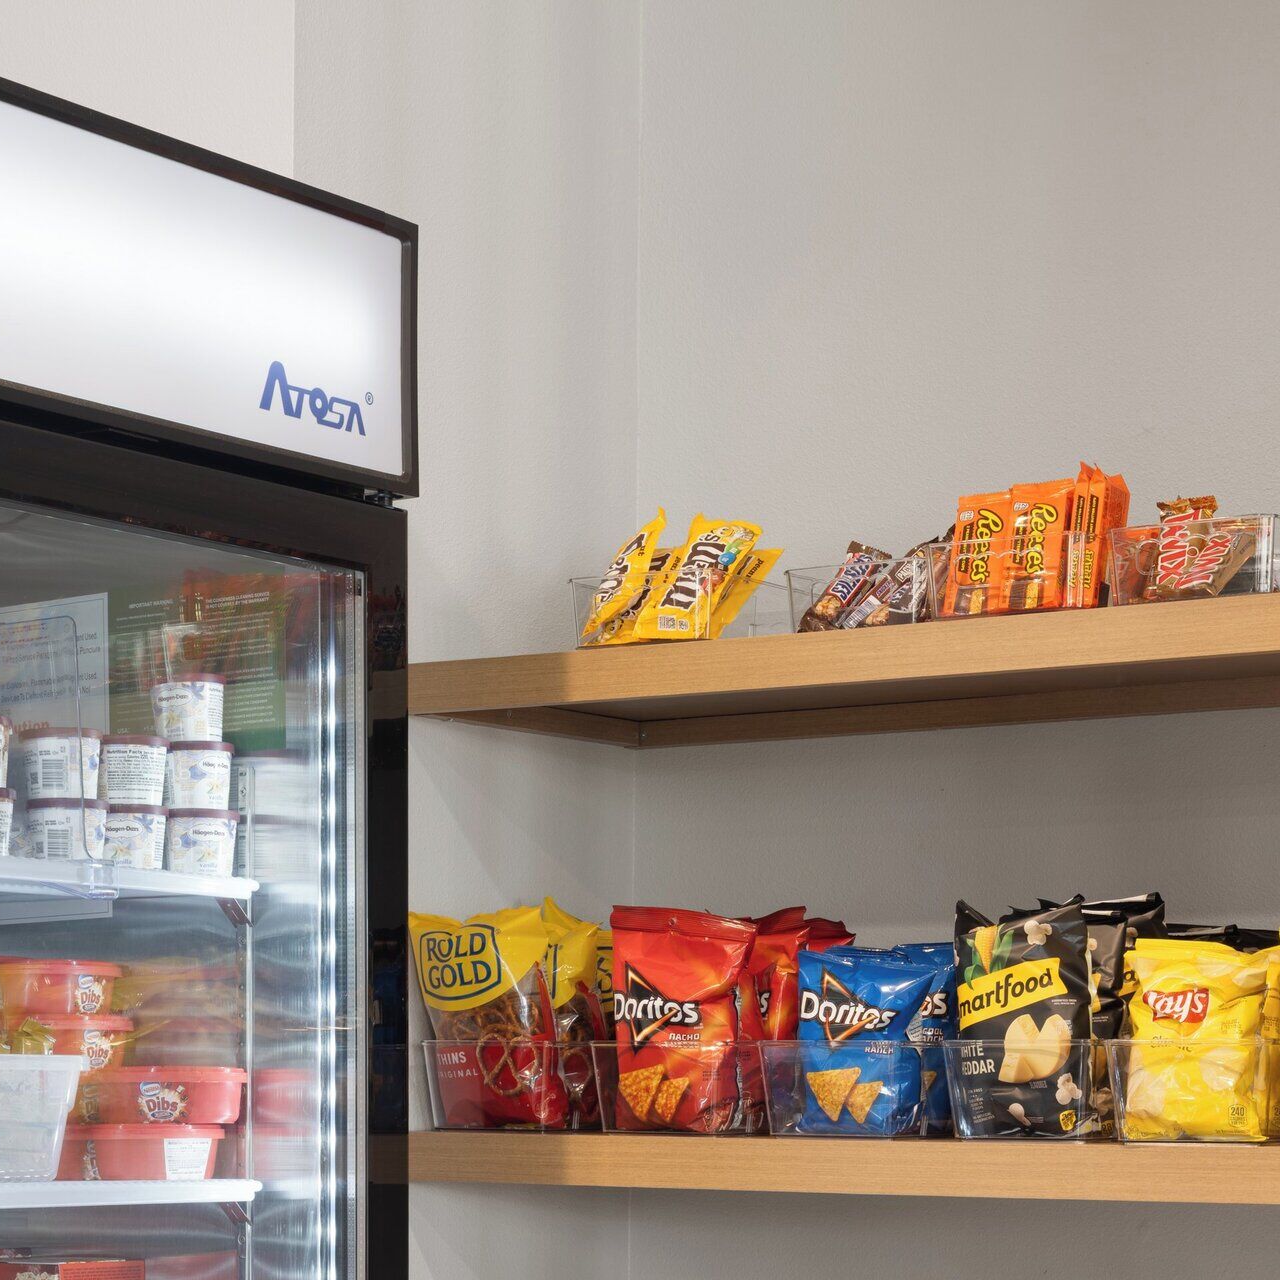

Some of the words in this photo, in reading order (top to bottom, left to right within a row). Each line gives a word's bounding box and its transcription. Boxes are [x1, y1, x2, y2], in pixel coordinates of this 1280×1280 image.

[970, 508, 1004, 583] Reese's
[1025, 503, 1058, 574] Reese's
[427, 936, 486, 963] ROLD
[427, 962, 491, 988] GOLD
[80, 989, 101, 1004] Dibs
[959, 968, 1054, 1018] martfood
[613, 993, 701, 1025] Doritos
[801, 989, 896, 1029] Doritos
[669, 1032, 701, 1042] NACHO
[86, 1046, 110, 1060] Dibs
[436, 1051, 468, 1065] THINS
[145, 1096, 179, 1113] Dibs
